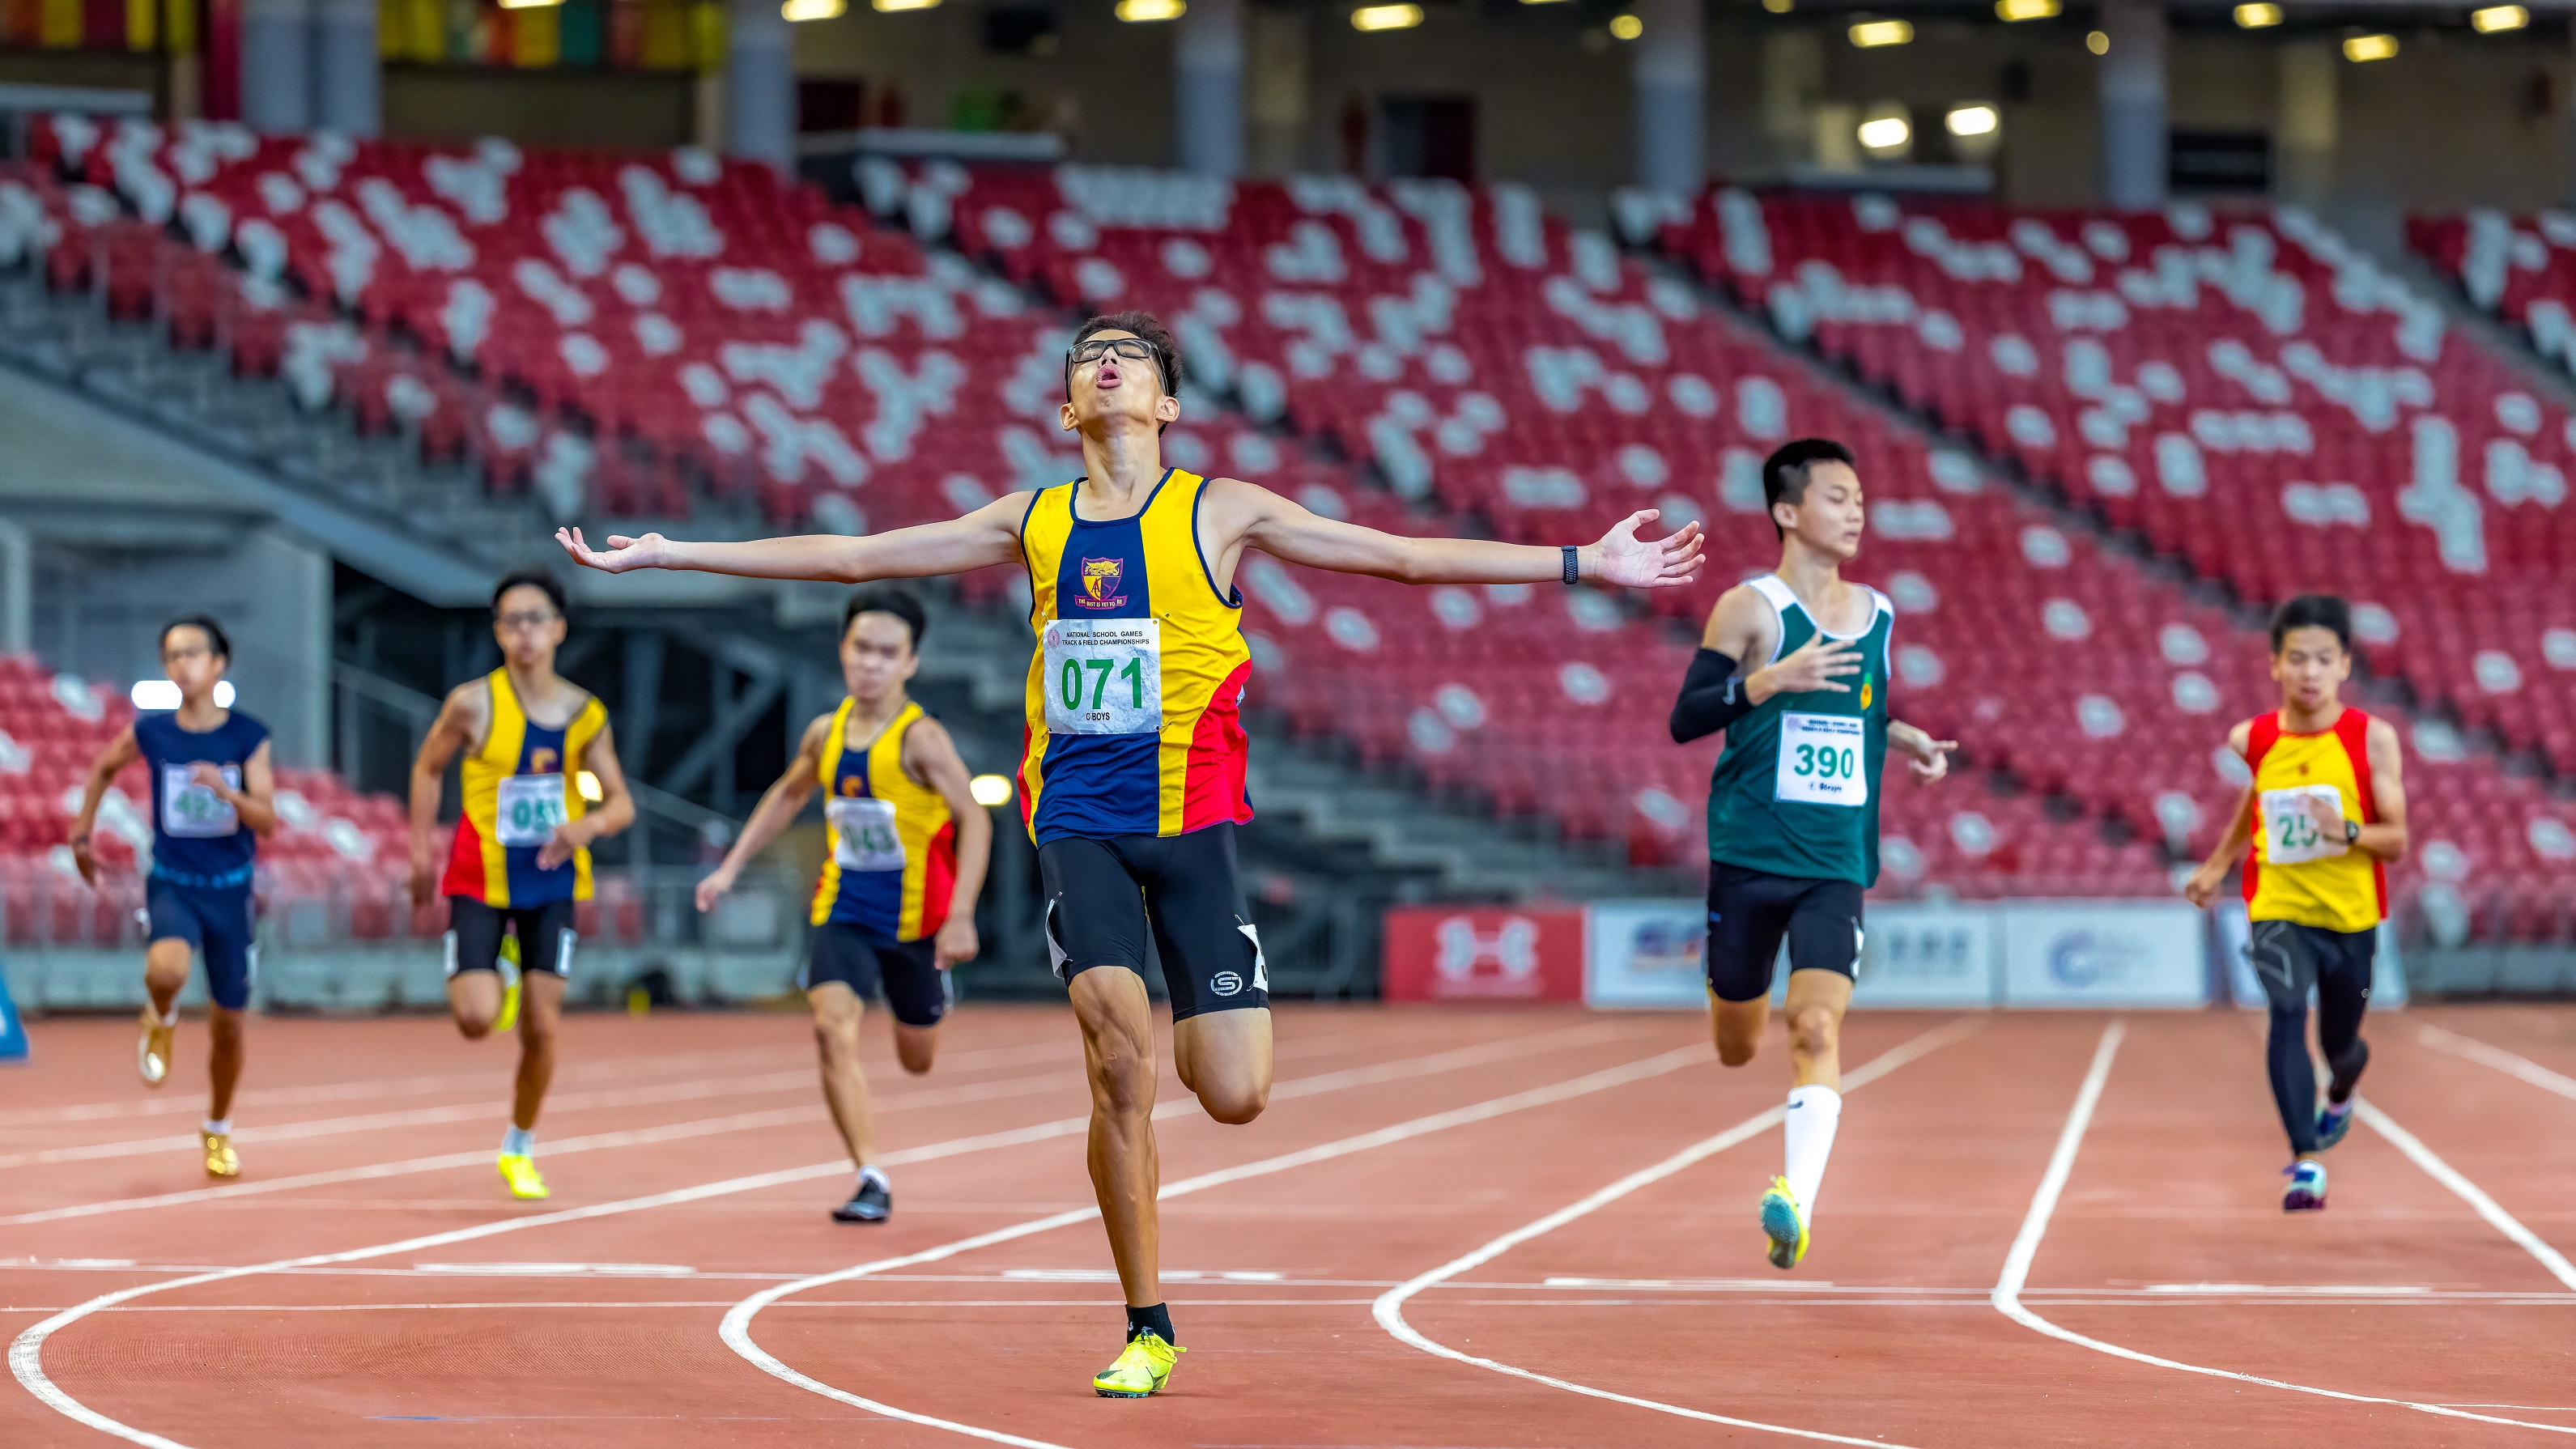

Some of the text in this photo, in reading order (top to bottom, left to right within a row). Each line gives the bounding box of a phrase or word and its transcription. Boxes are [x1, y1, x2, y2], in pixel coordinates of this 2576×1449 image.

[1061, 657, 1142, 711] 071
[1086, 712, 1110, 720] C BOYS
[1794, 743, 1854, 779] 390
[2277, 813, 2319, 848] 25
